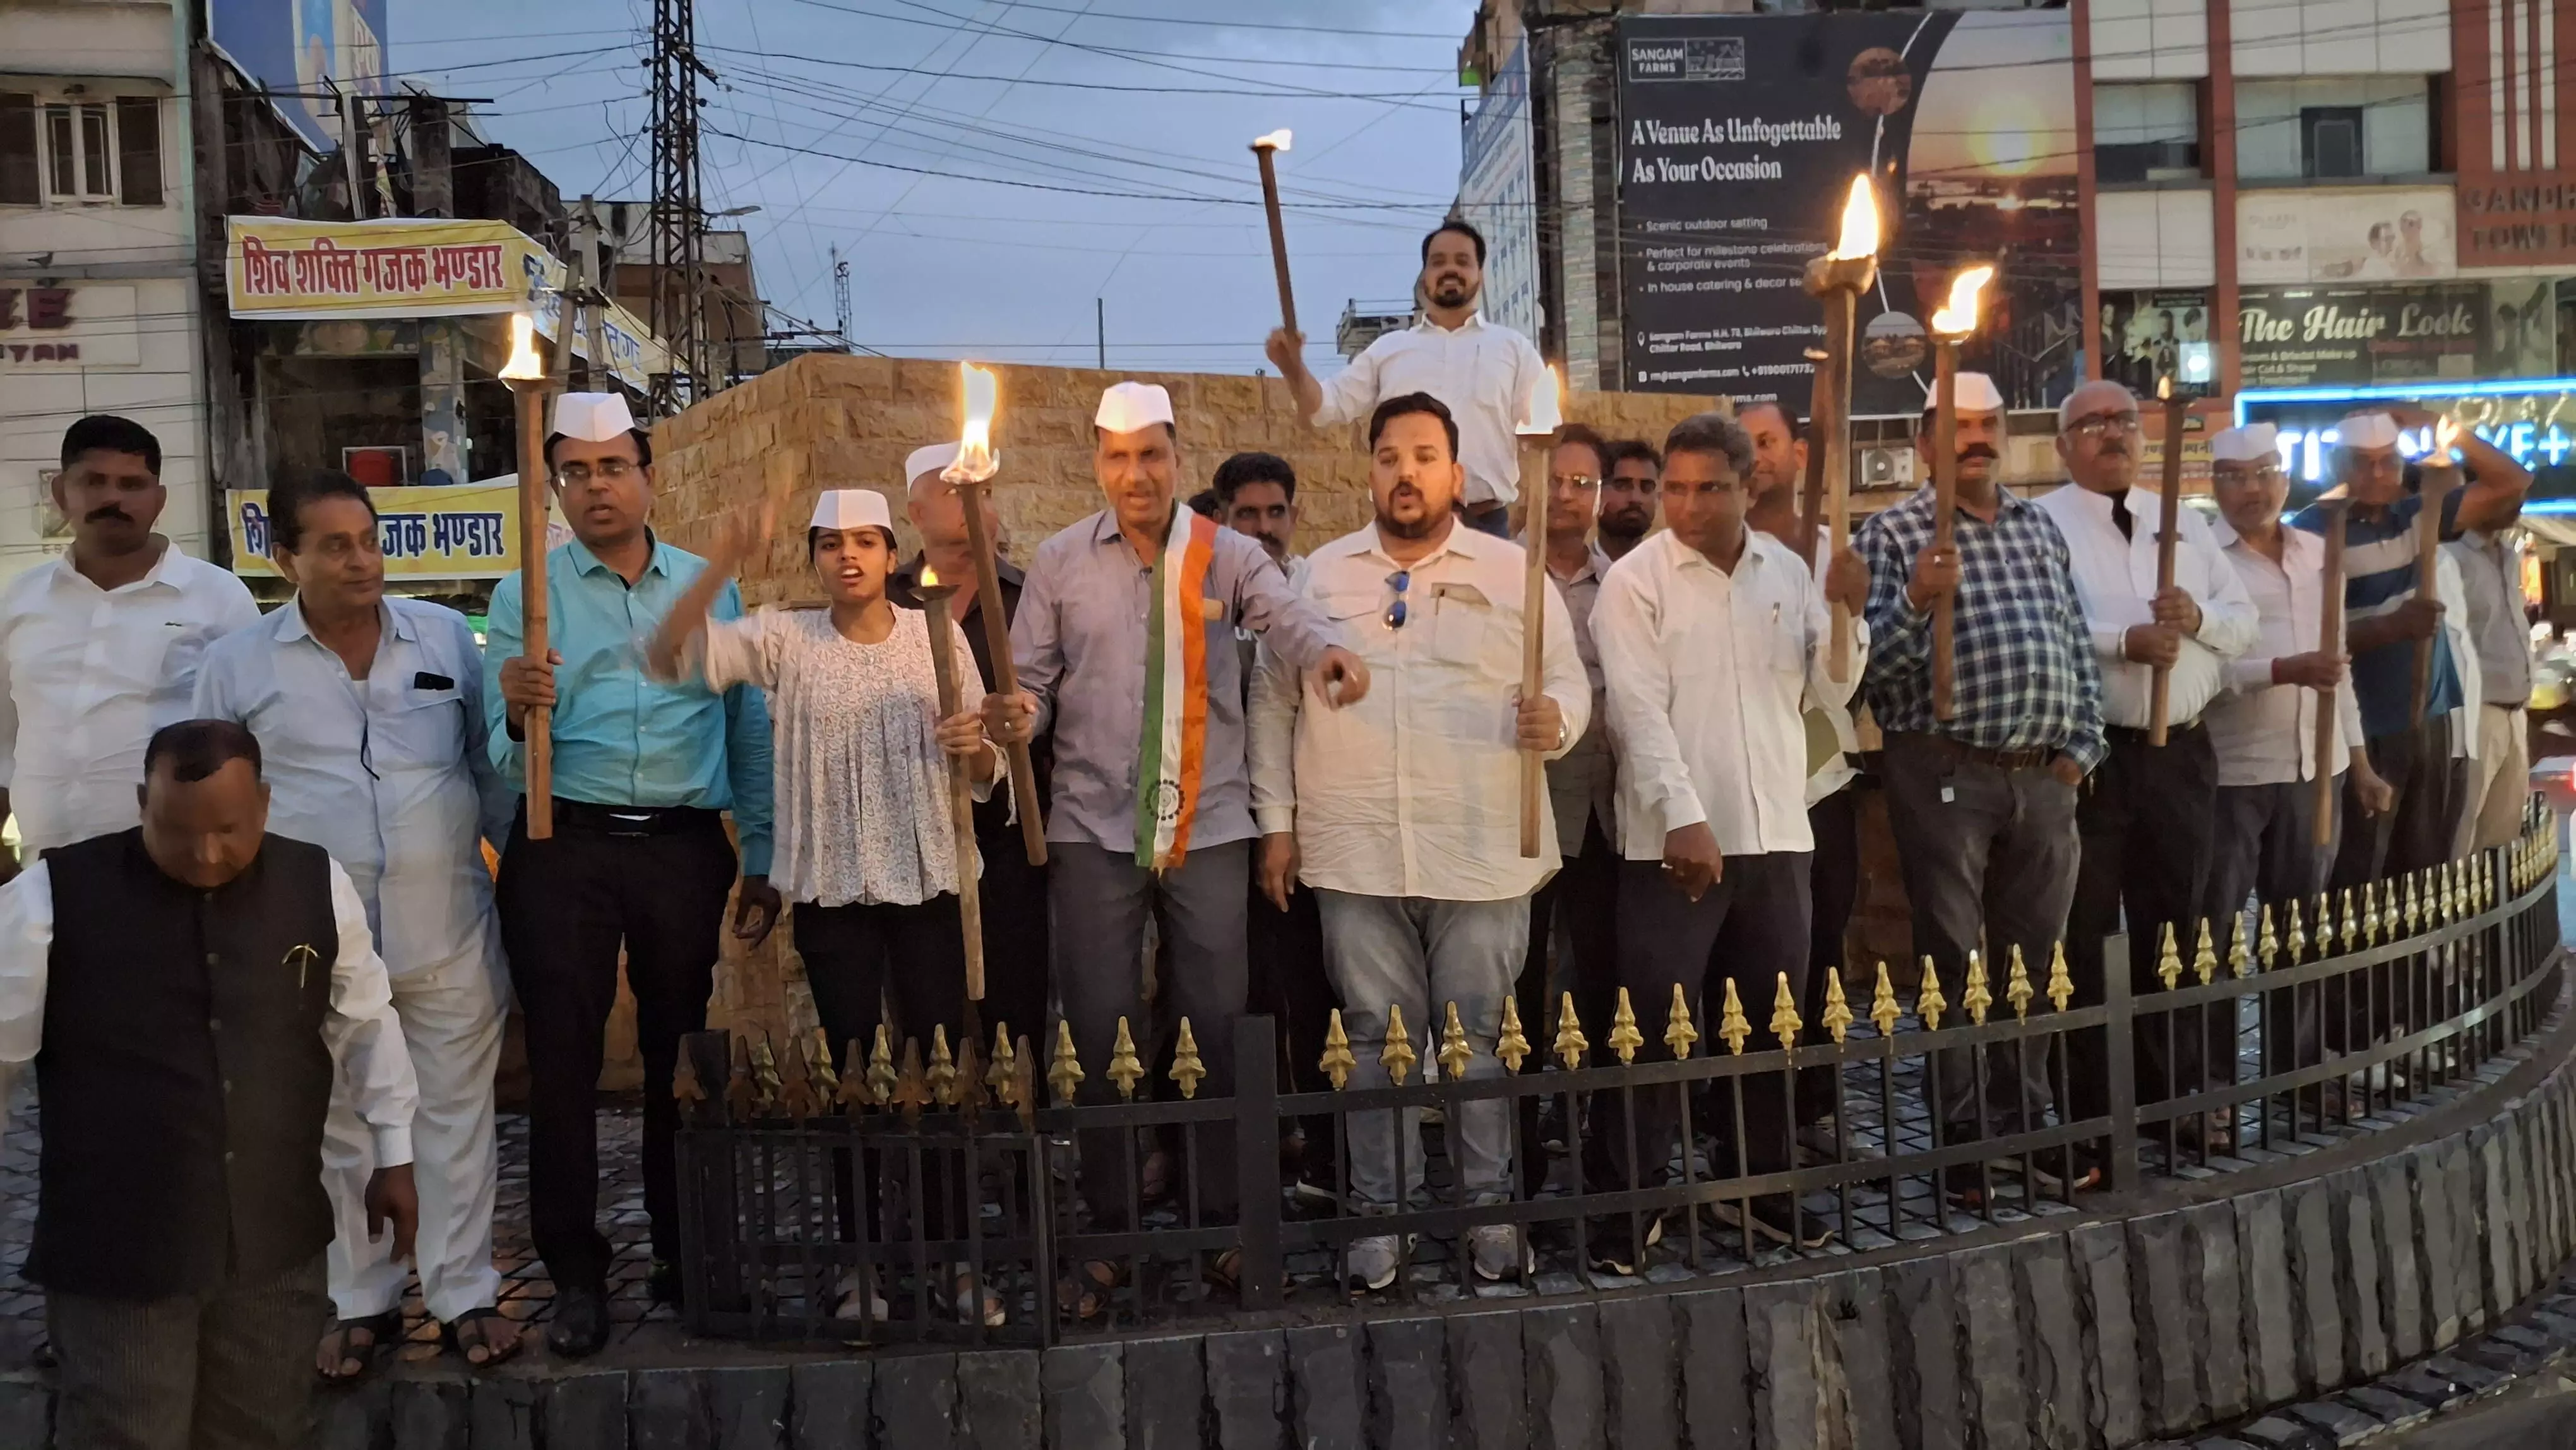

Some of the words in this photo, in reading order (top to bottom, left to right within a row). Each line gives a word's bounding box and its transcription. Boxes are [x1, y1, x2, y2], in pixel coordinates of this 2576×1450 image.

[1631, 48, 1684, 61] SANGAM
[1639, 63, 1676, 73] FARMS
[1631, 120, 1645, 145] A
[1646, 119, 1700, 145] Venue
[1702, 118, 1724, 143] As
[1727, 114, 1842, 147] Unfogettable
[1632, 158, 1655, 183] As
[1657, 157, 1698, 182] Your
[1701, 154, 1782, 182] Occasion
[1647, 220, 1682, 232] Scenic
[1685, 219, 1727, 230] outdoor
[1731, 217, 1768, 231] setting
[1647, 247, 1685, 259] Perfect
[1687, 246, 1702, 256] for
[1705, 244, 1757, 256] milestone
[242, 236, 291, 294] शिव
[292, 237, 359, 294] शक्ति
[361, 248, 427, 292] गजक
[432, 245, 504, 290] भण्डार
[1647, 261, 1655, 272] &
[1658, 260, 1712, 273] corporate
[1714, 258, 1751, 268] events
[1648, 284, 1657, 292] In
[1661, 282, 1693, 292] house
[1696, 279, 1743, 292] catering
[1744, 278, 1752, 289] &
[1755, 277, 1786, 287] decor
[2238, 308, 2296, 344] The
[2303, 304, 2388, 342] Hair
[2397, 303, 2474, 338] Look
[241, 503, 270, 559] शि
[378, 513, 427, 558] जक
[433, 513, 504, 557] भण्डार
